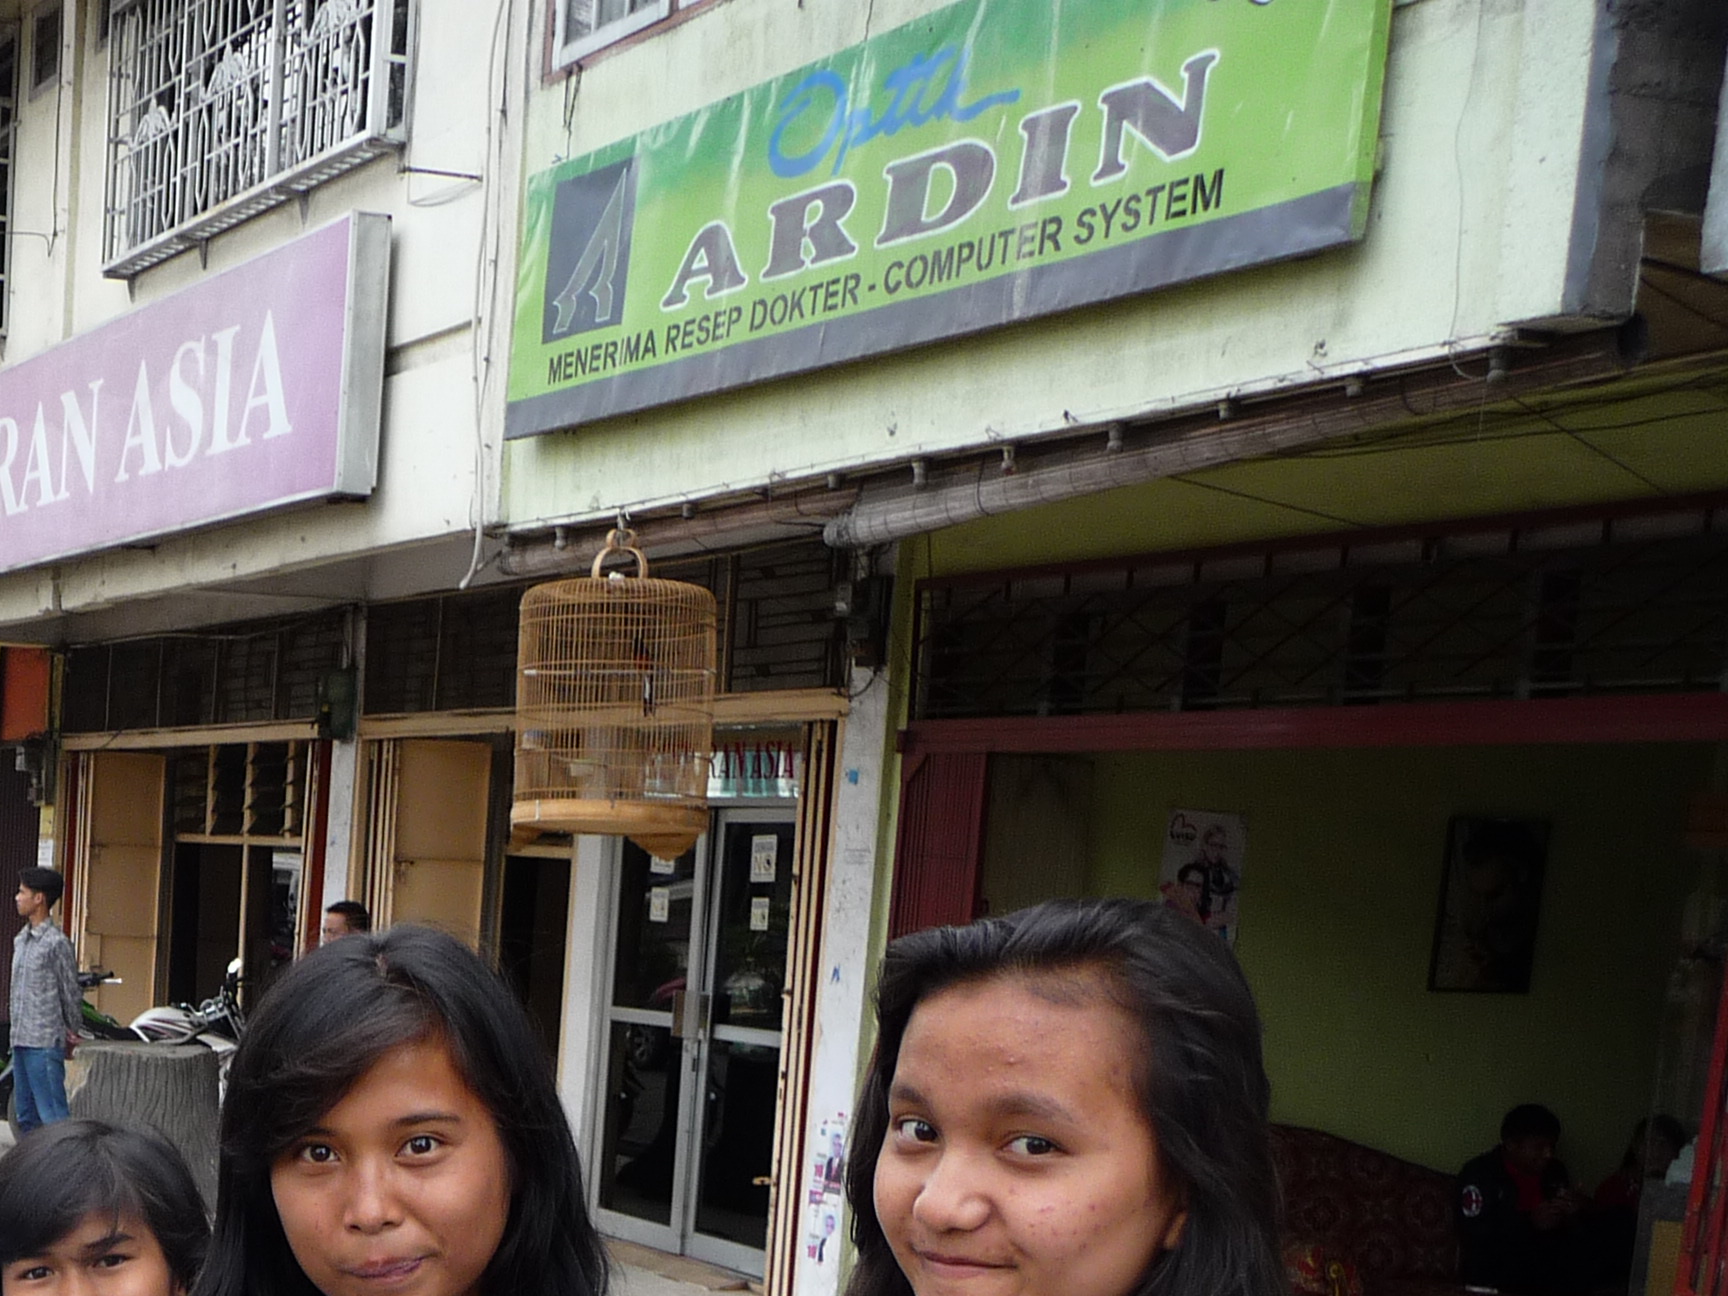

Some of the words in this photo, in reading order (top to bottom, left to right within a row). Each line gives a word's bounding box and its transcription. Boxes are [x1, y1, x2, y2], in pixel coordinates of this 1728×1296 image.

[548, 330, 656, 385] MENERIMA
[665, 306, 742, 355] RESEP
[750, 273, 862, 332] DOKTER
[883, 215, 1062, 295] COMPUTER
[1074, 168, 1225, 246] SYSTEM
[660, 48, 1220, 312] ARDIN
[115, 309, 293, 483] ASIA
[751, 742, 795, 779] ASIA
